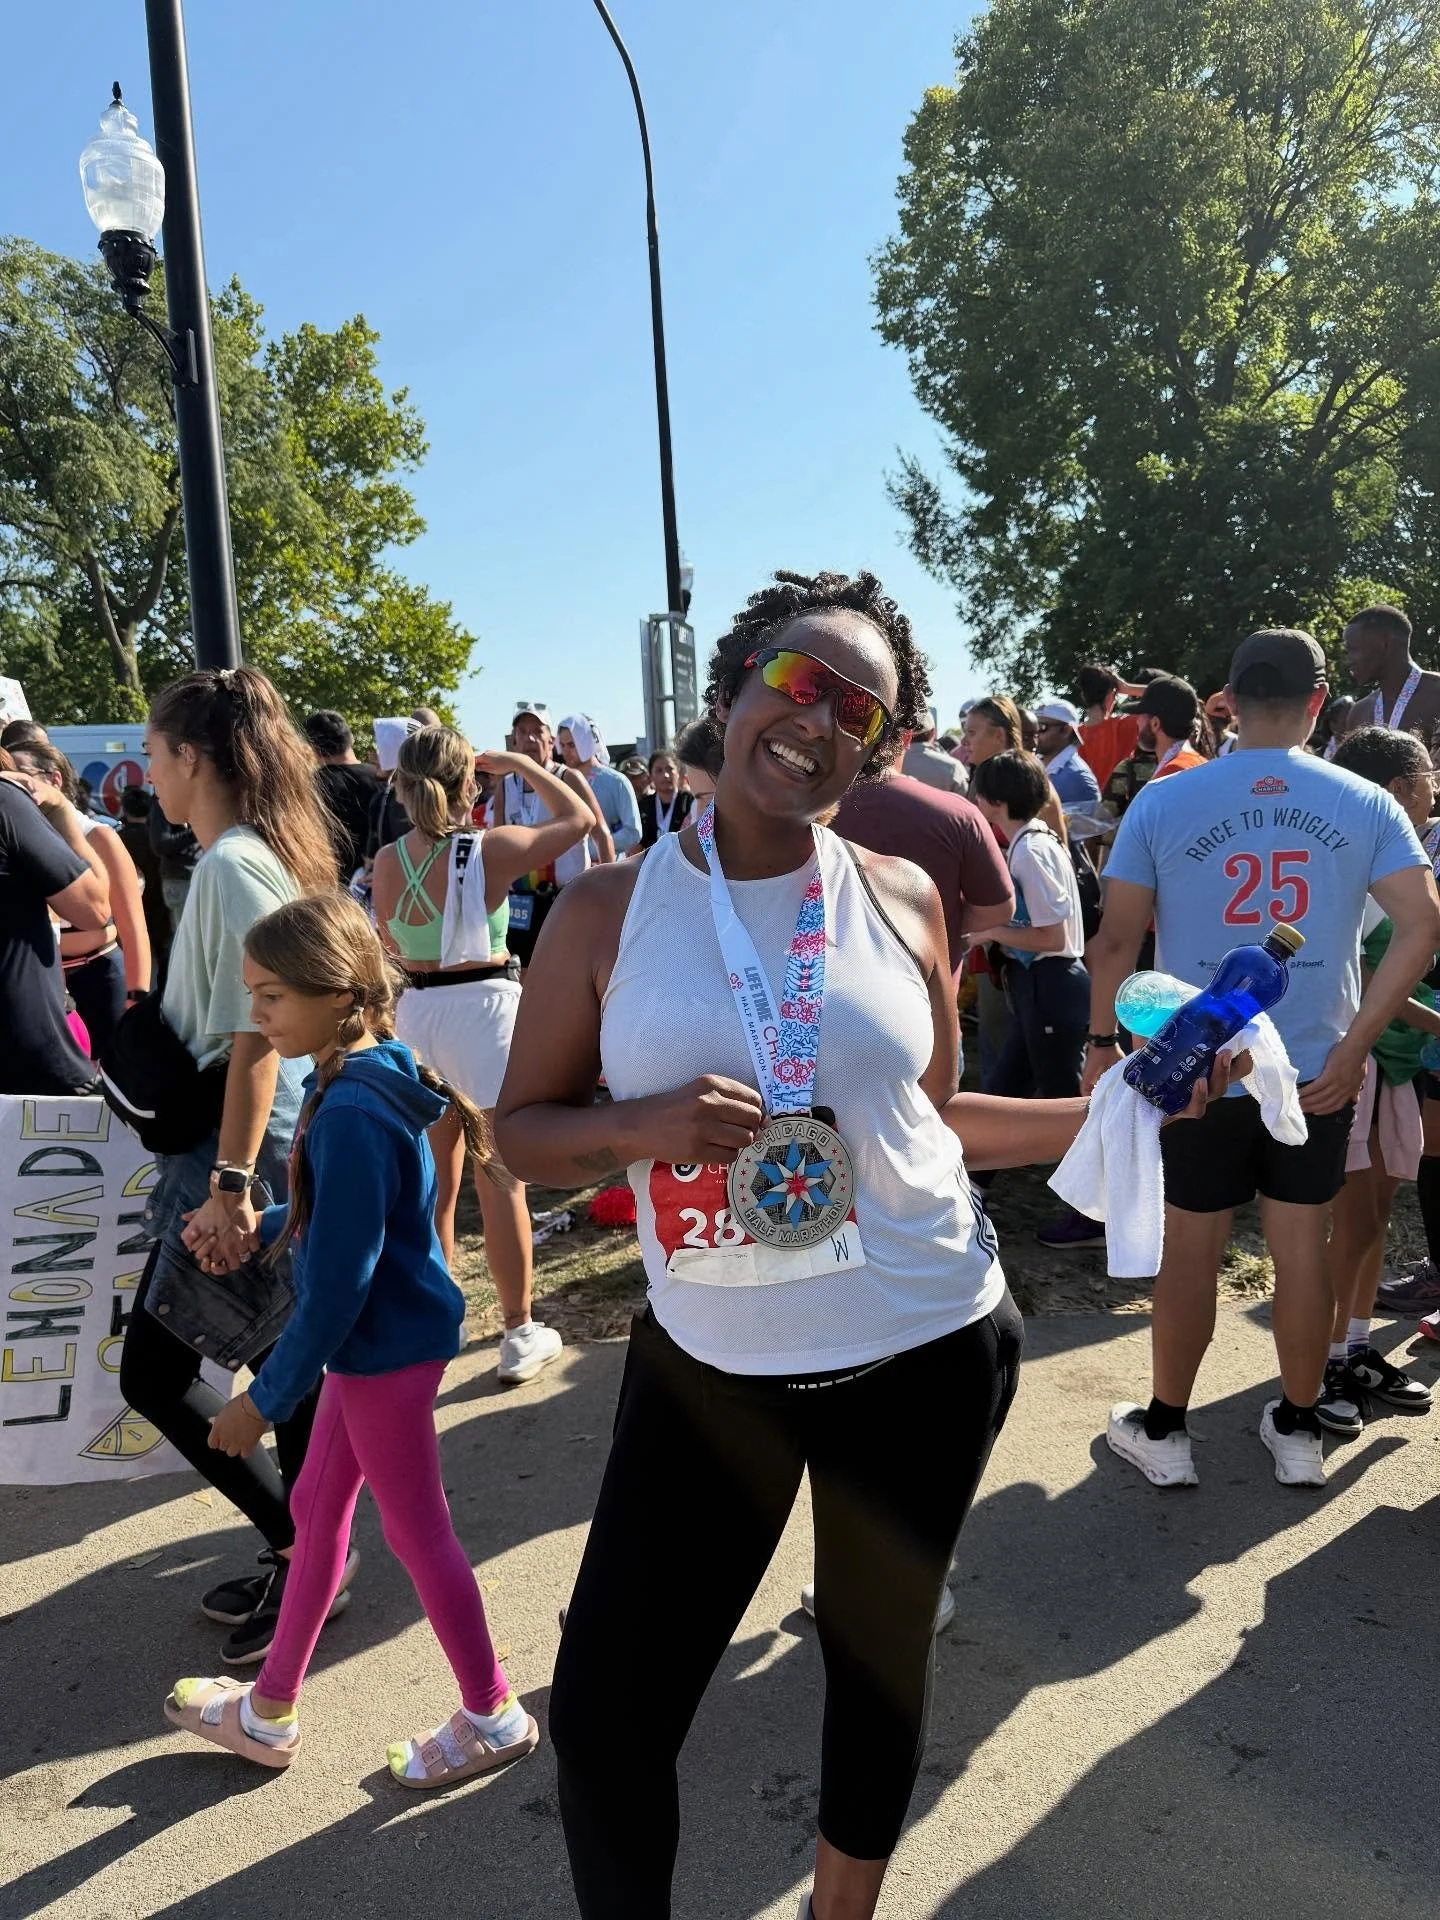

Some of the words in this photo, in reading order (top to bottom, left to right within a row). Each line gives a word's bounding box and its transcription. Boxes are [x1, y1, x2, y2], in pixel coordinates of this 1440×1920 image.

[1185, 819, 1237, 862] RACE
[1240, 808, 1265, 829] TO
[1273, 807, 1349, 852] WRIGLEY
[1222, 848, 1311, 926] 25
[741, 995, 752, 1017] HALF
[748, 1021, 767, 1071] MARATHON
[752, 1123, 830, 1153] CHICAGO
[679, 1207, 745, 1248] 28
[744, 1208, 776, 1237] HALF
[779, 1199, 845, 1243] MARATHON
[1, 1099, 112, 1427] LEMONADE
[830, 1232, 849, 1262] W
